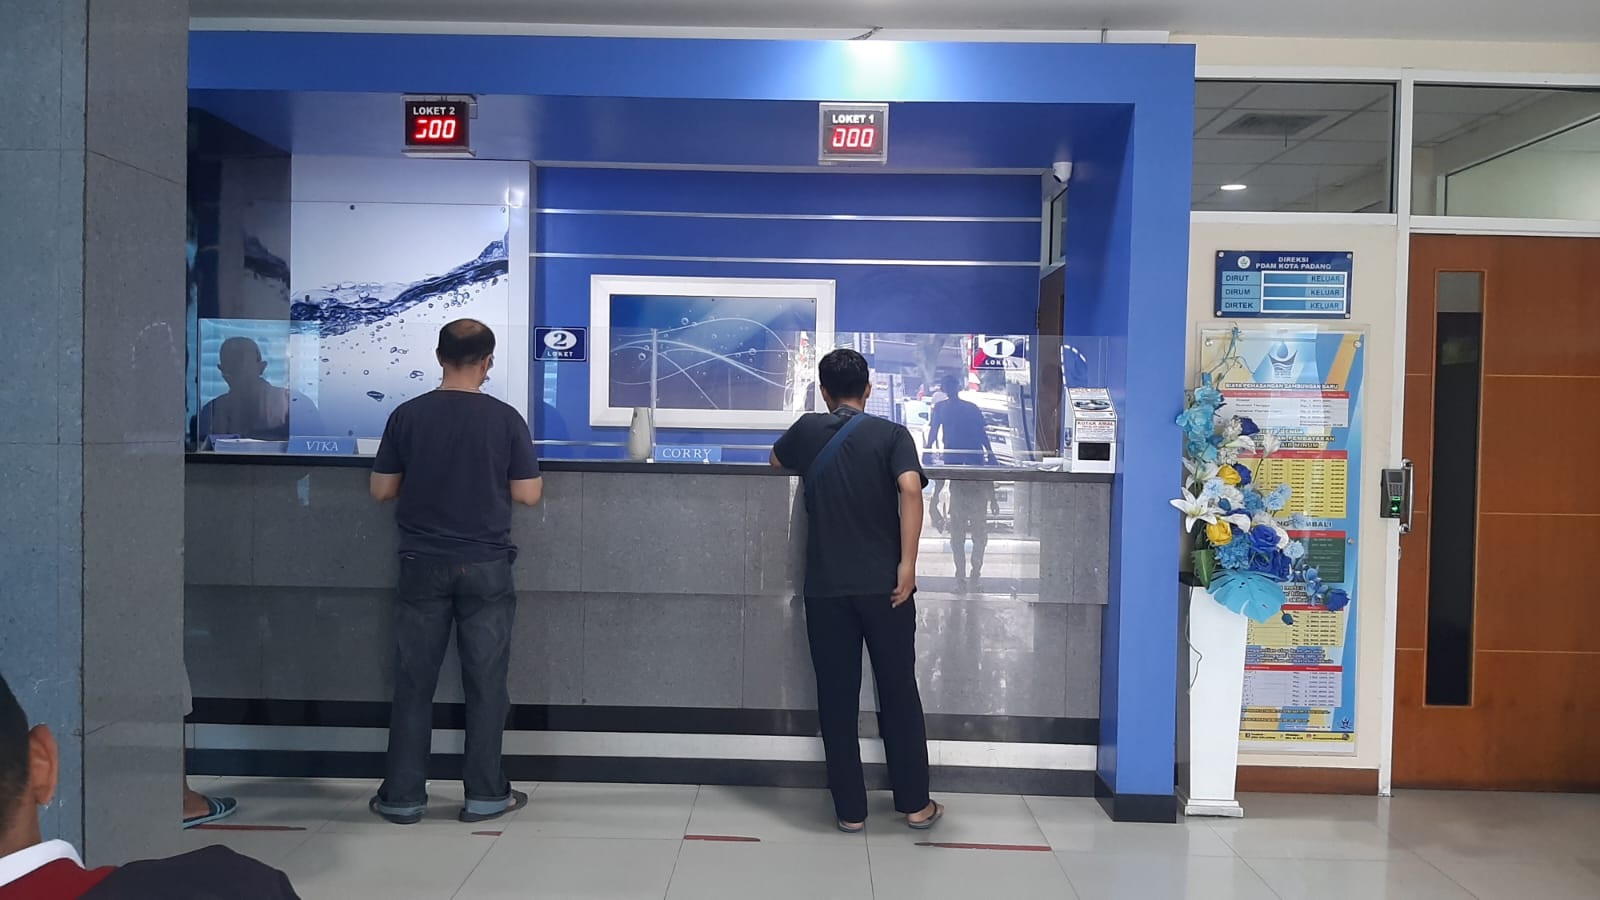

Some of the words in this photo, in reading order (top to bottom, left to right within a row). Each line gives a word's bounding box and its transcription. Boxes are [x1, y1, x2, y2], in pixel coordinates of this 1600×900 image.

[413, 106, 446, 115] LOKET
[449, 106, 456, 115] 2
[832, 114, 866, 124] LOKET
[868, 114, 875, 124] 1
[1225, 274, 1250, 282] DIRUT
[1225, 288, 1250, 296] DIRUM
[1224, 301, 1253, 309] DIRTEK
[552, 332, 568, 347] 2
[994, 341, 1004, 355] 1
[306, 440, 339, 452] VIKA
[662, 447, 713, 460] CORRY
